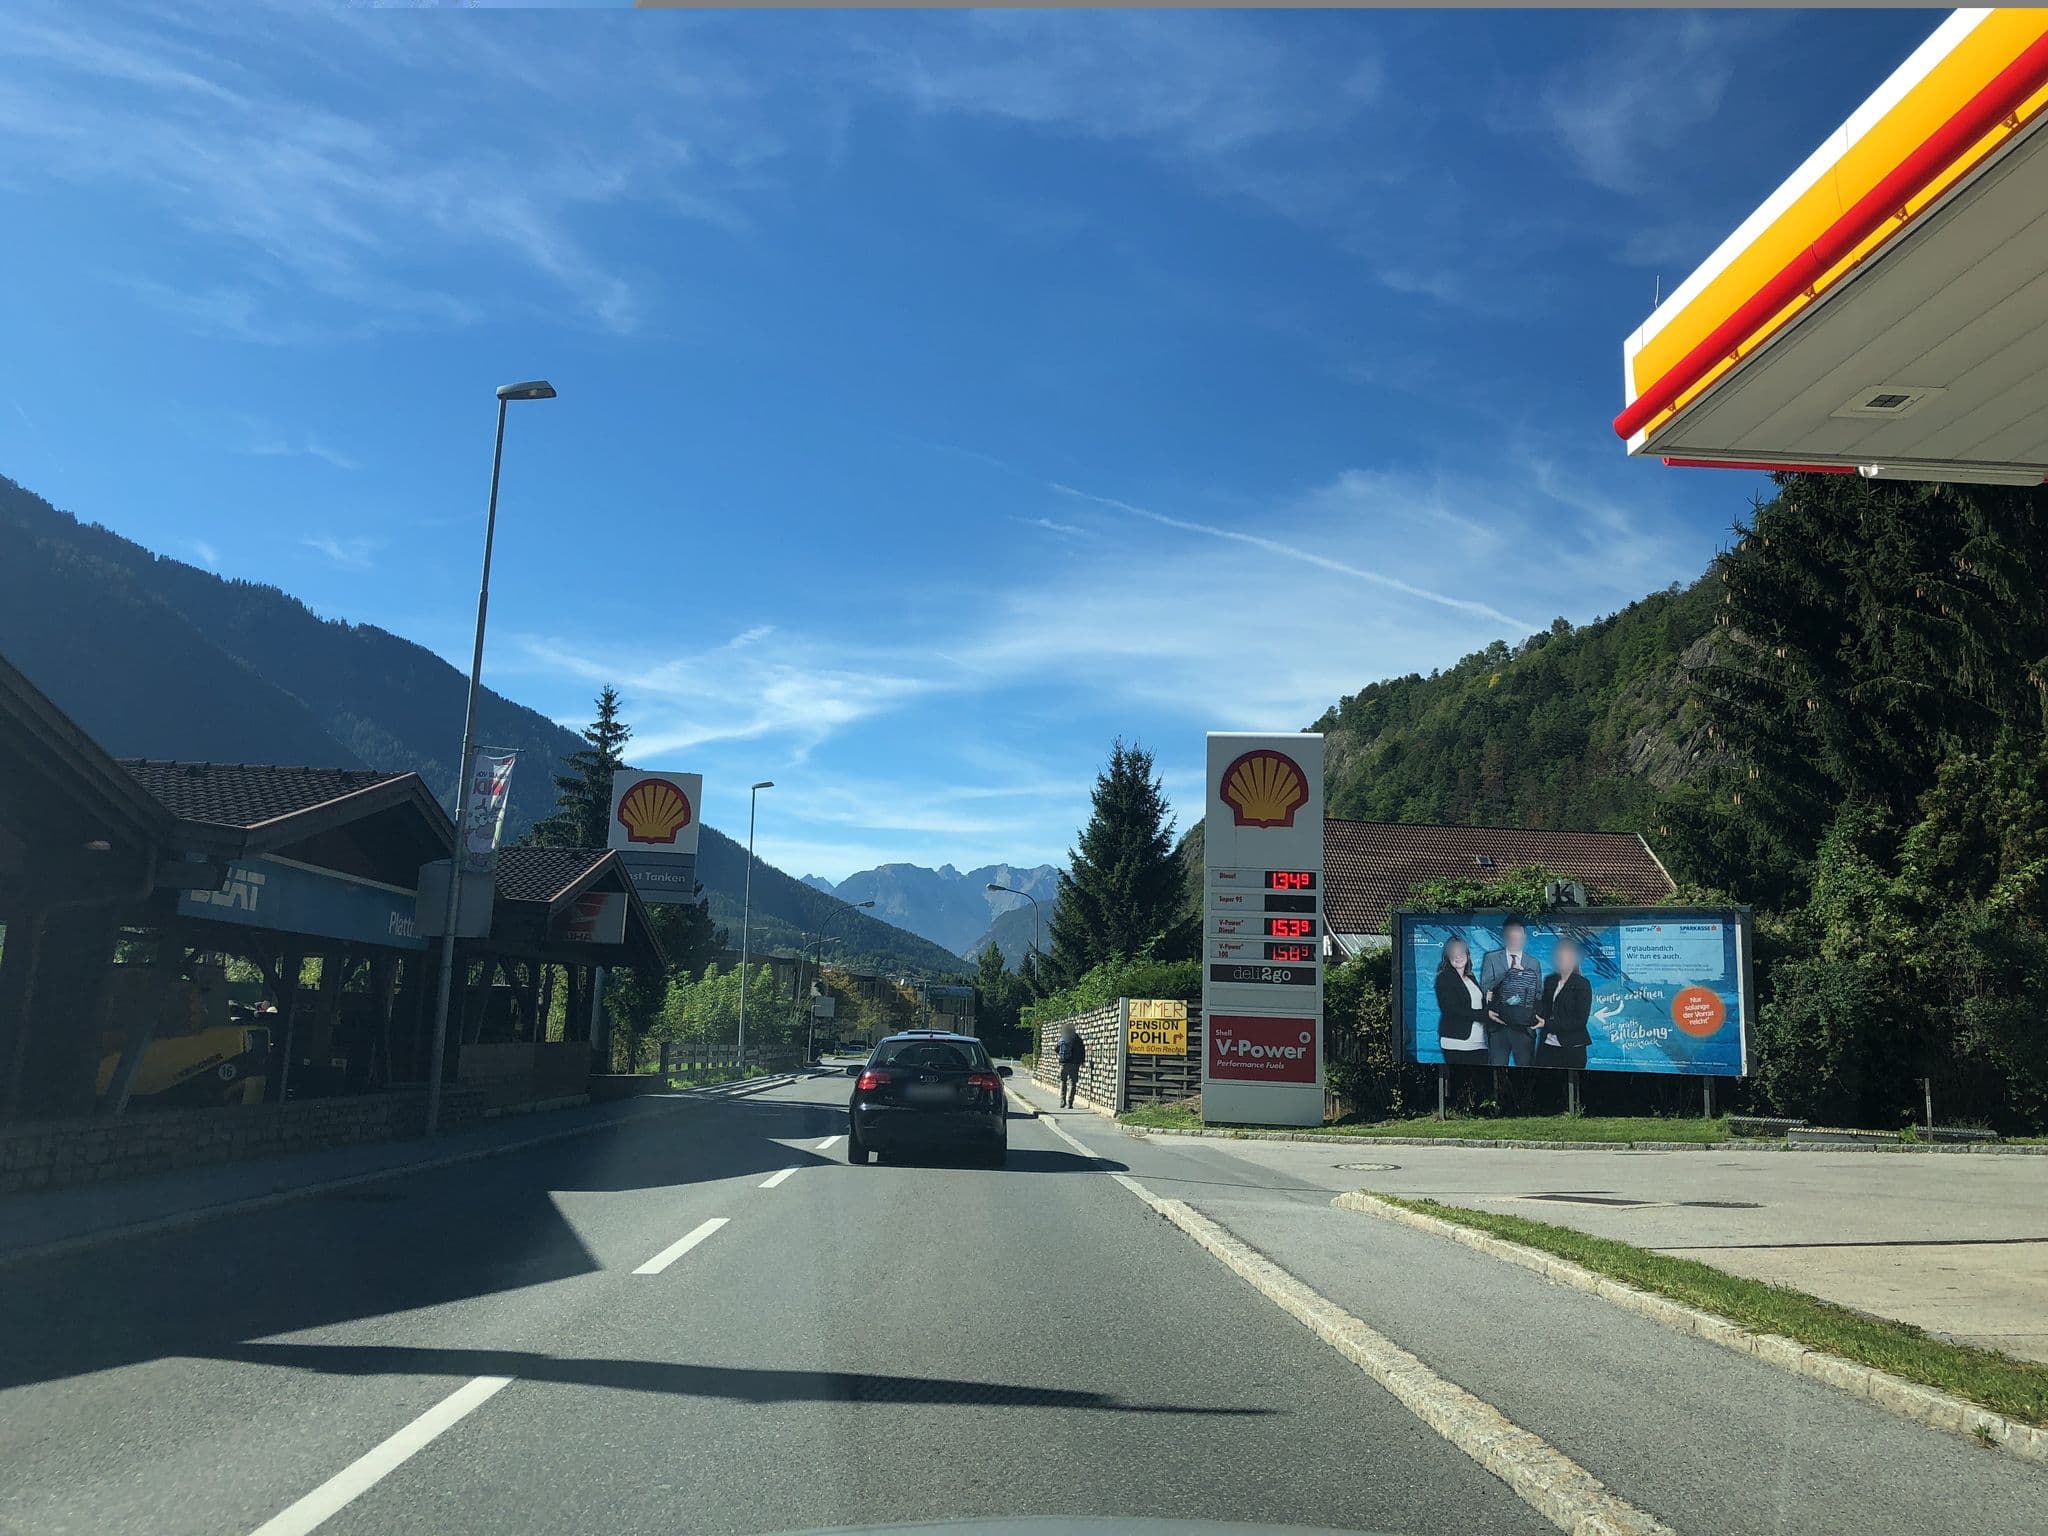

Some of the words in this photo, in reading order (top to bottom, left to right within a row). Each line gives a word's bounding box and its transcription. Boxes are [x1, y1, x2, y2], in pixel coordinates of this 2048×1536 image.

[646, 871, 686, 882] Tanken
[1219, 872, 1237, 880] Diesel
[1626, 945, 1674, 953] #glaubandich
[1233, 966, 1292, 983] deli2go
[1129, 1001, 1183, 1018] ZIMMER
[1694, 1010, 1714, 1018] Vorrat
[1129, 1020, 1179, 1030] PENSION
[1130, 1031, 1170, 1044] POHL
[1215, 1029, 1233, 1037] Shell
[1215, 1038, 1307, 1059] V-Power
[1216, 1059, 1265, 1069] Performance
[1265, 1061, 1285, 1070] Fuels
